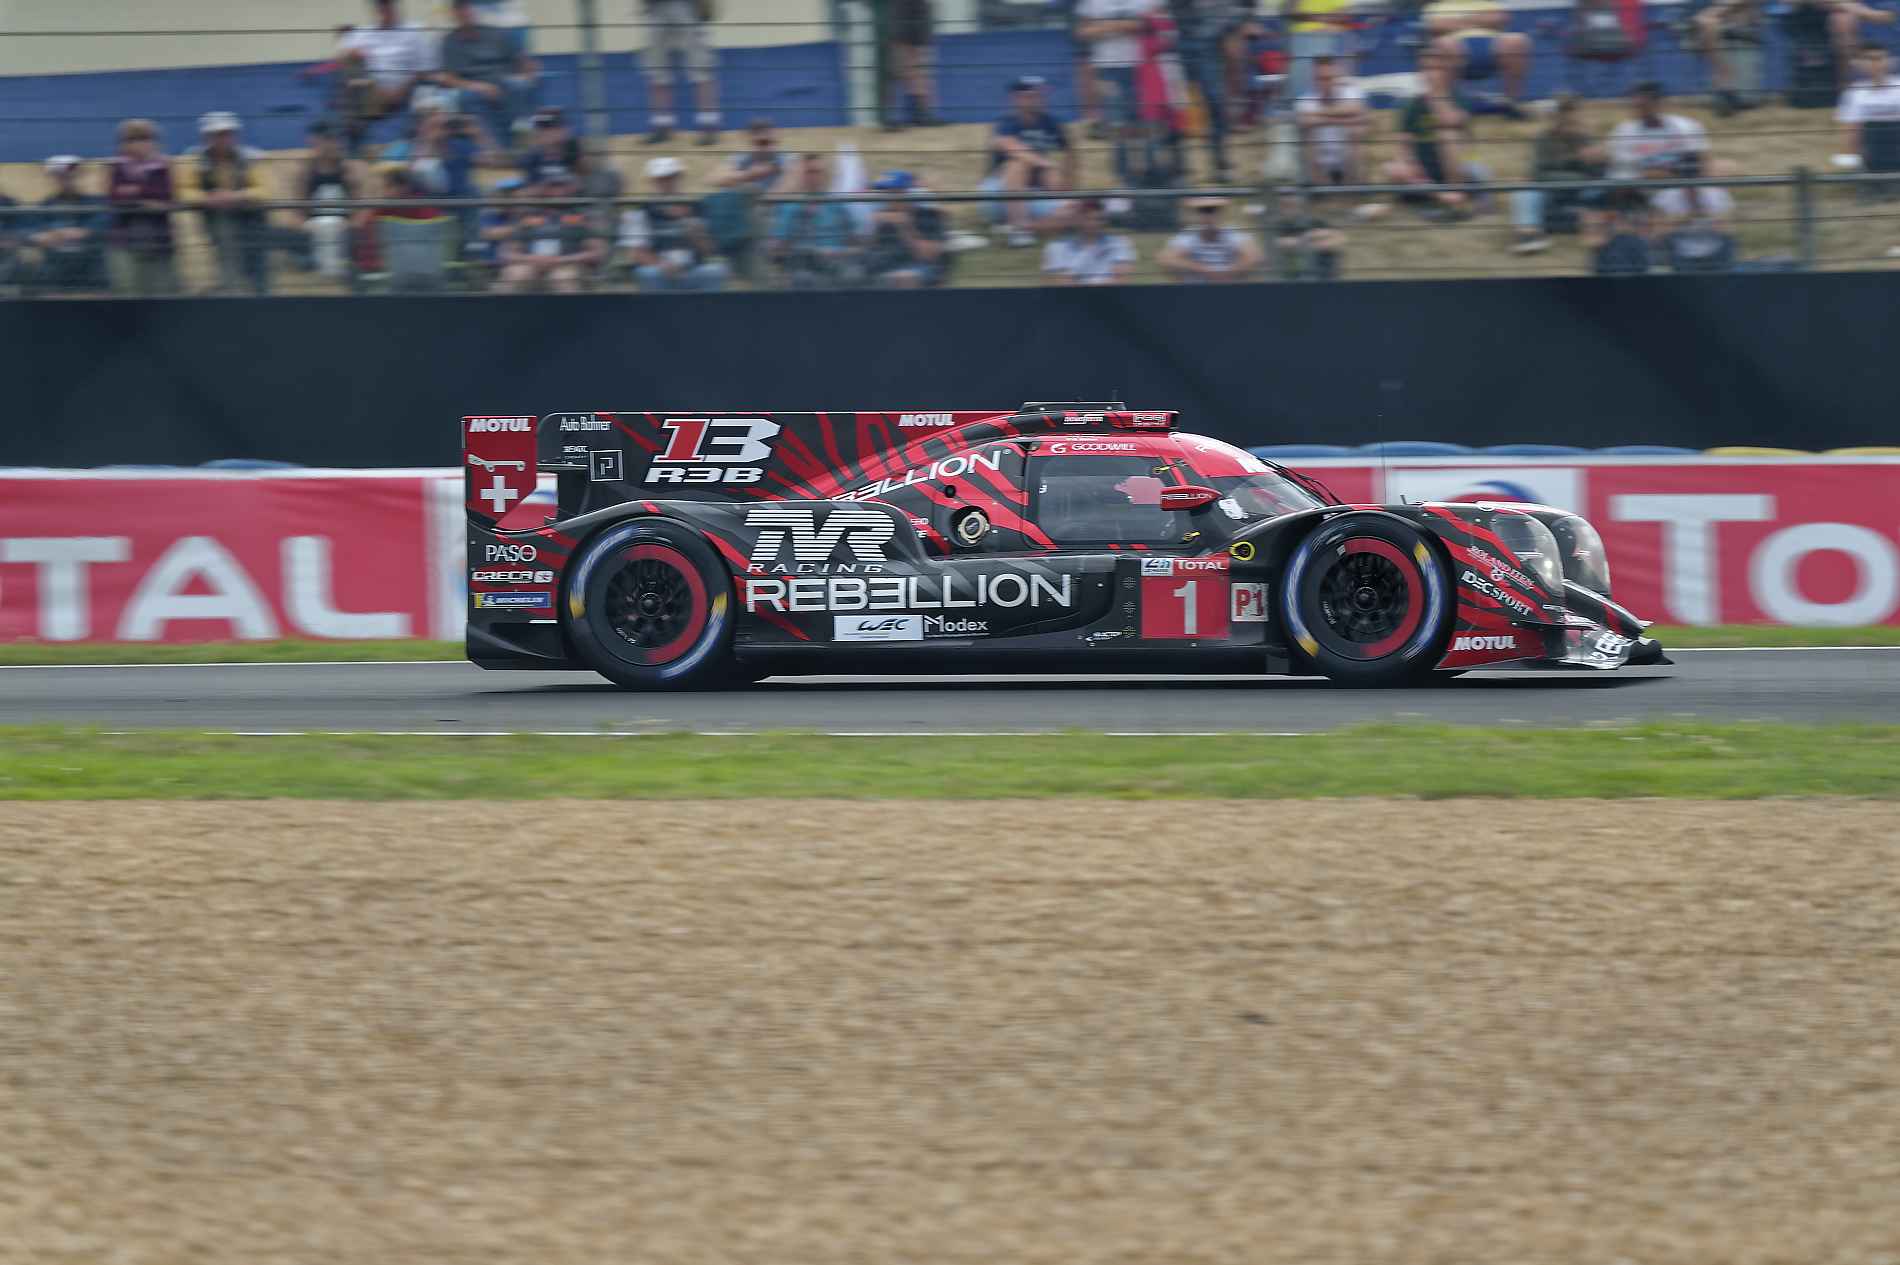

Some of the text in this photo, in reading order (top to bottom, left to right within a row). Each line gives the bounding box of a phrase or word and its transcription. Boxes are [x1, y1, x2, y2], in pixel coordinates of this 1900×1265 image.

[469, 418, 531, 432] MOTUL
[898, 413, 954, 426] MOTUL
[652, 418, 780, 463] 13
[744, 509, 896, 562] TVR
[485, 544, 537, 562] PASO
[746, 562, 884, 574] RACING
[1174, 559, 1229, 571] TOTAL
[0, 535, 413, 641] TAL
[1173, 580, 1198, 635] 1
[1235, 589, 1264, 617] P1
[924, 615, 989, 633] Modex
[1454, 636, 1517, 651] MOTUL
